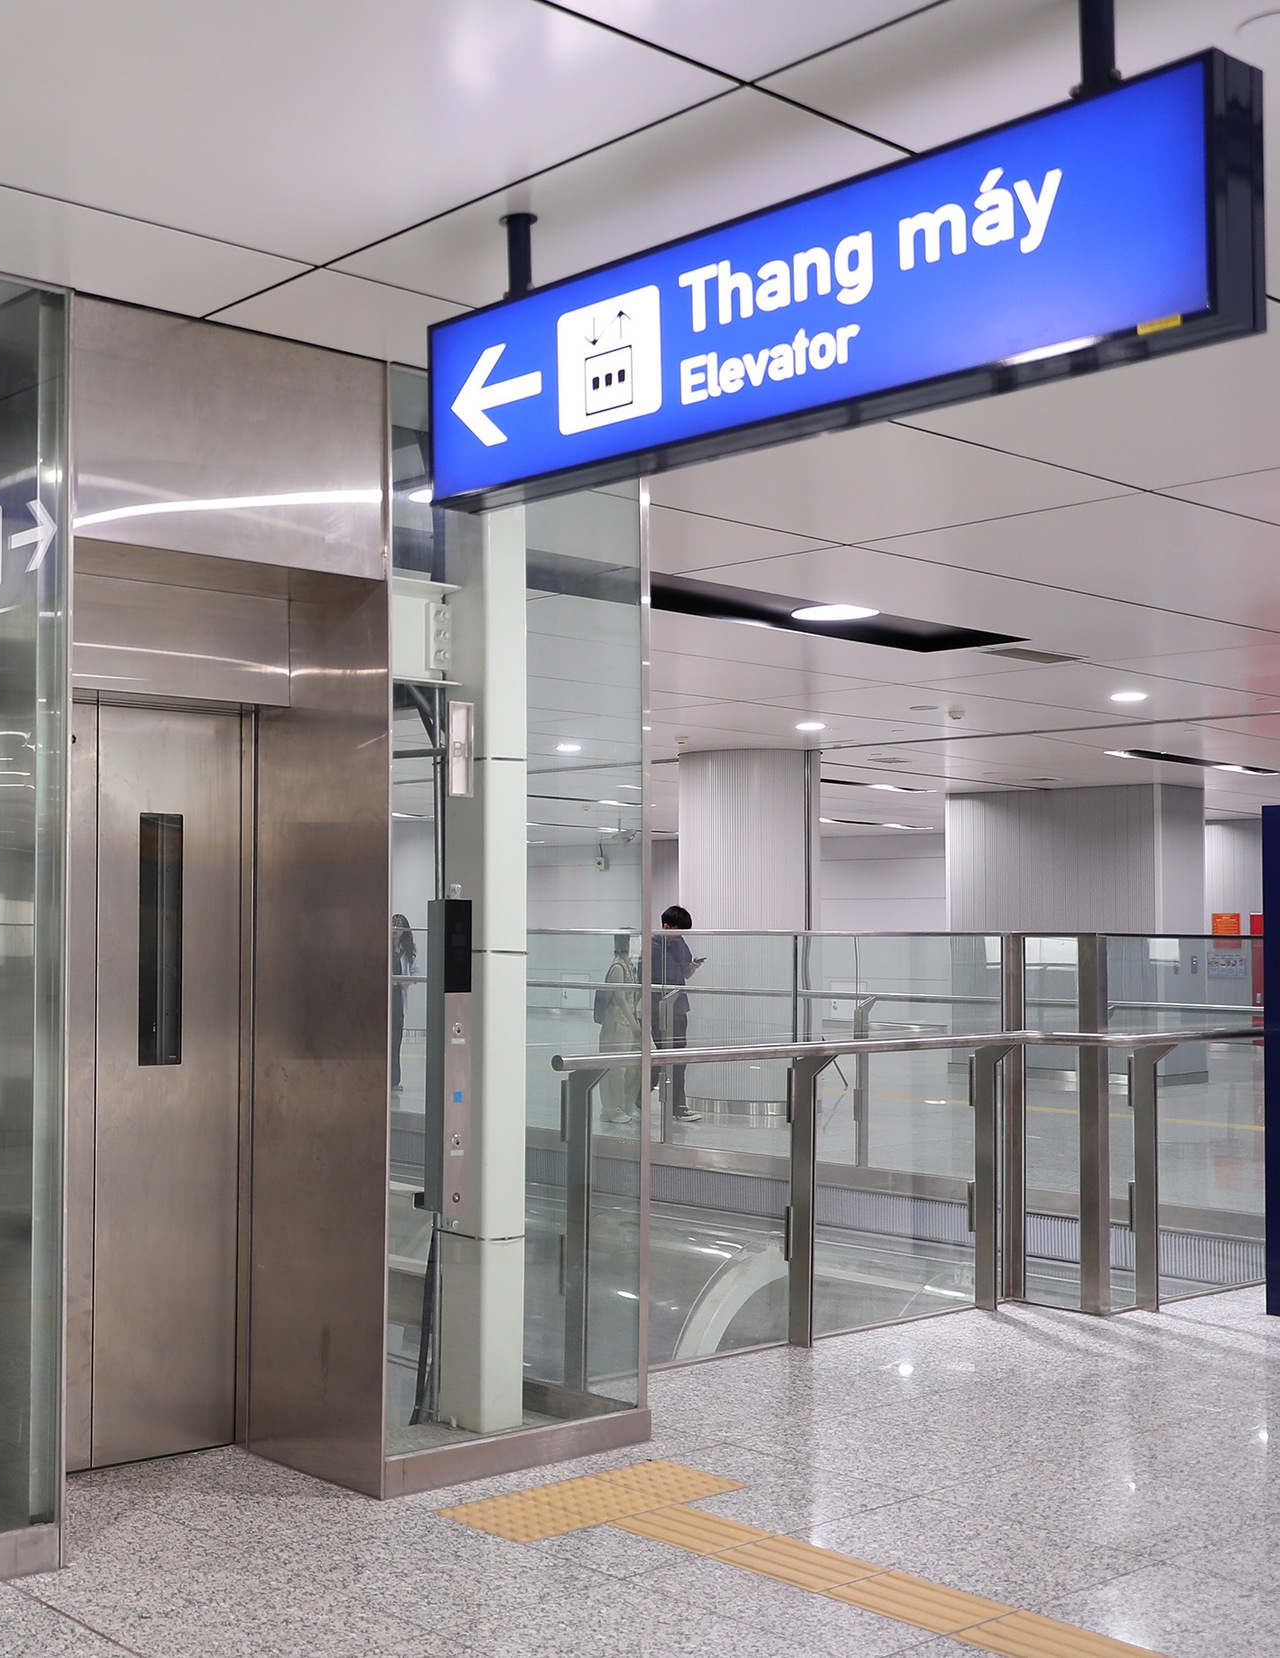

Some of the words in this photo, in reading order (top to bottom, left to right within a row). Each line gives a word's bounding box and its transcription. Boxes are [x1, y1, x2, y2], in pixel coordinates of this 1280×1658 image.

[678, 230, 874, 333] Thang
[898, 166, 1064, 271] máy
[680, 323, 861, 406] Elevator
